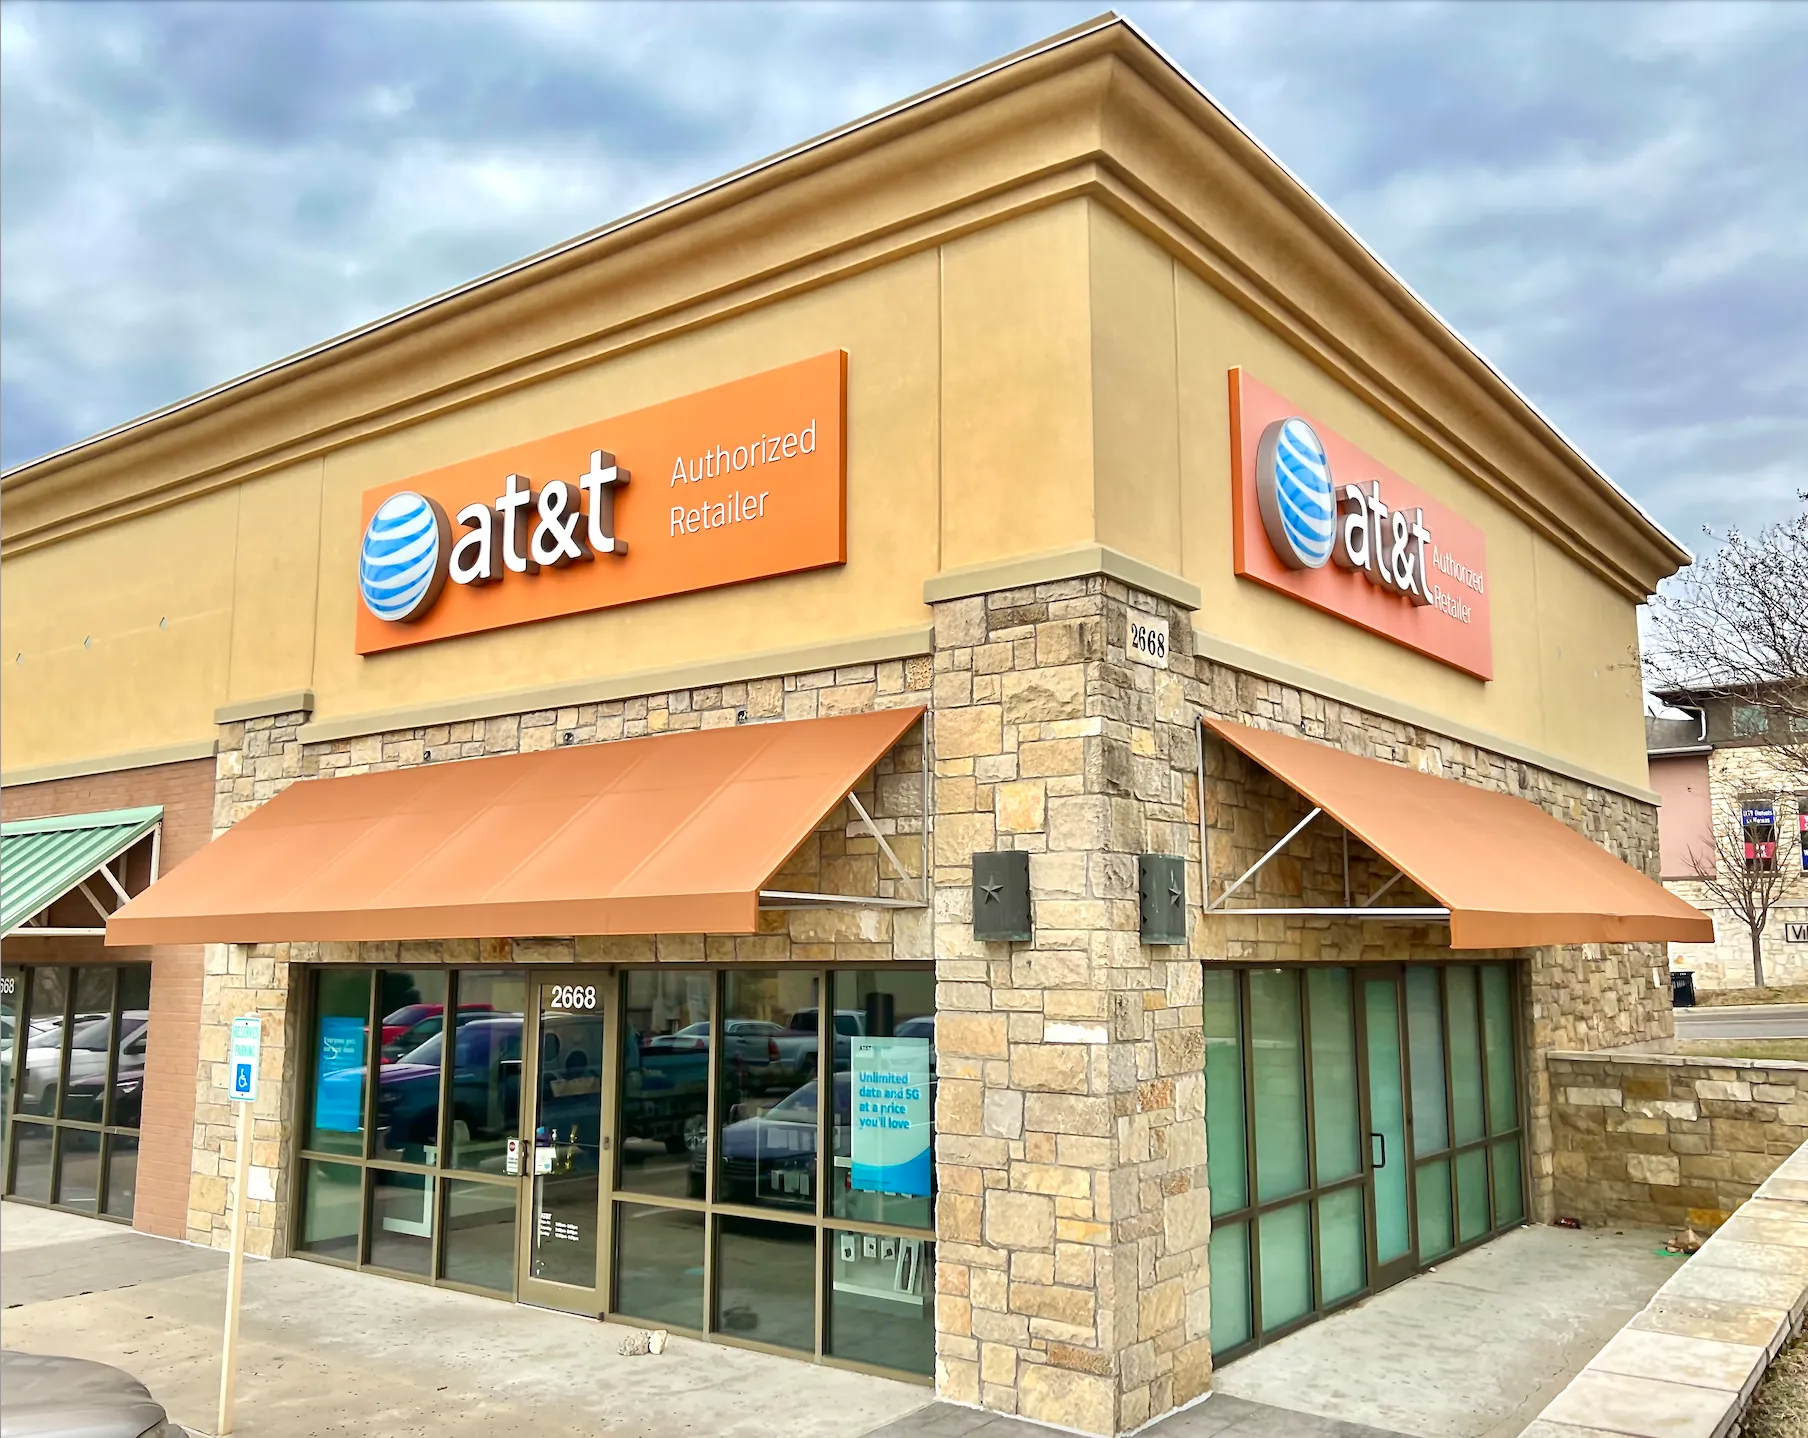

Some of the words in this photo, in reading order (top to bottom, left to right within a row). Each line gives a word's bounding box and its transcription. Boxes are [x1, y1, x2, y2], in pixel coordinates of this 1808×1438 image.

[669, 418, 818, 489] Authorized
[448, 448, 619, 587] at&t
[669, 489, 770, 538] Retailer
[1343, 479, 1434, 606] at&t
[1432, 544, 1485, 595] Authorized
[1433, 585, 1472, 625] Retailer
[1131, 622, 1166, 659] 2668
[551, 985, 597, 1010] 2668
[859, 1071, 909, 1084] Unlimited
[859, 1086, 881, 1098] data
[884, 1087, 904, 1099] and
[905, 1088, 920, 1100] 5G
[859, 1102, 870, 1112] at
[872, 1104, 878, 1113] a
[880, 1102, 906, 1115] price
[859, 1117, 886, 1130] you'll
[888, 1117, 910, 1129] love
